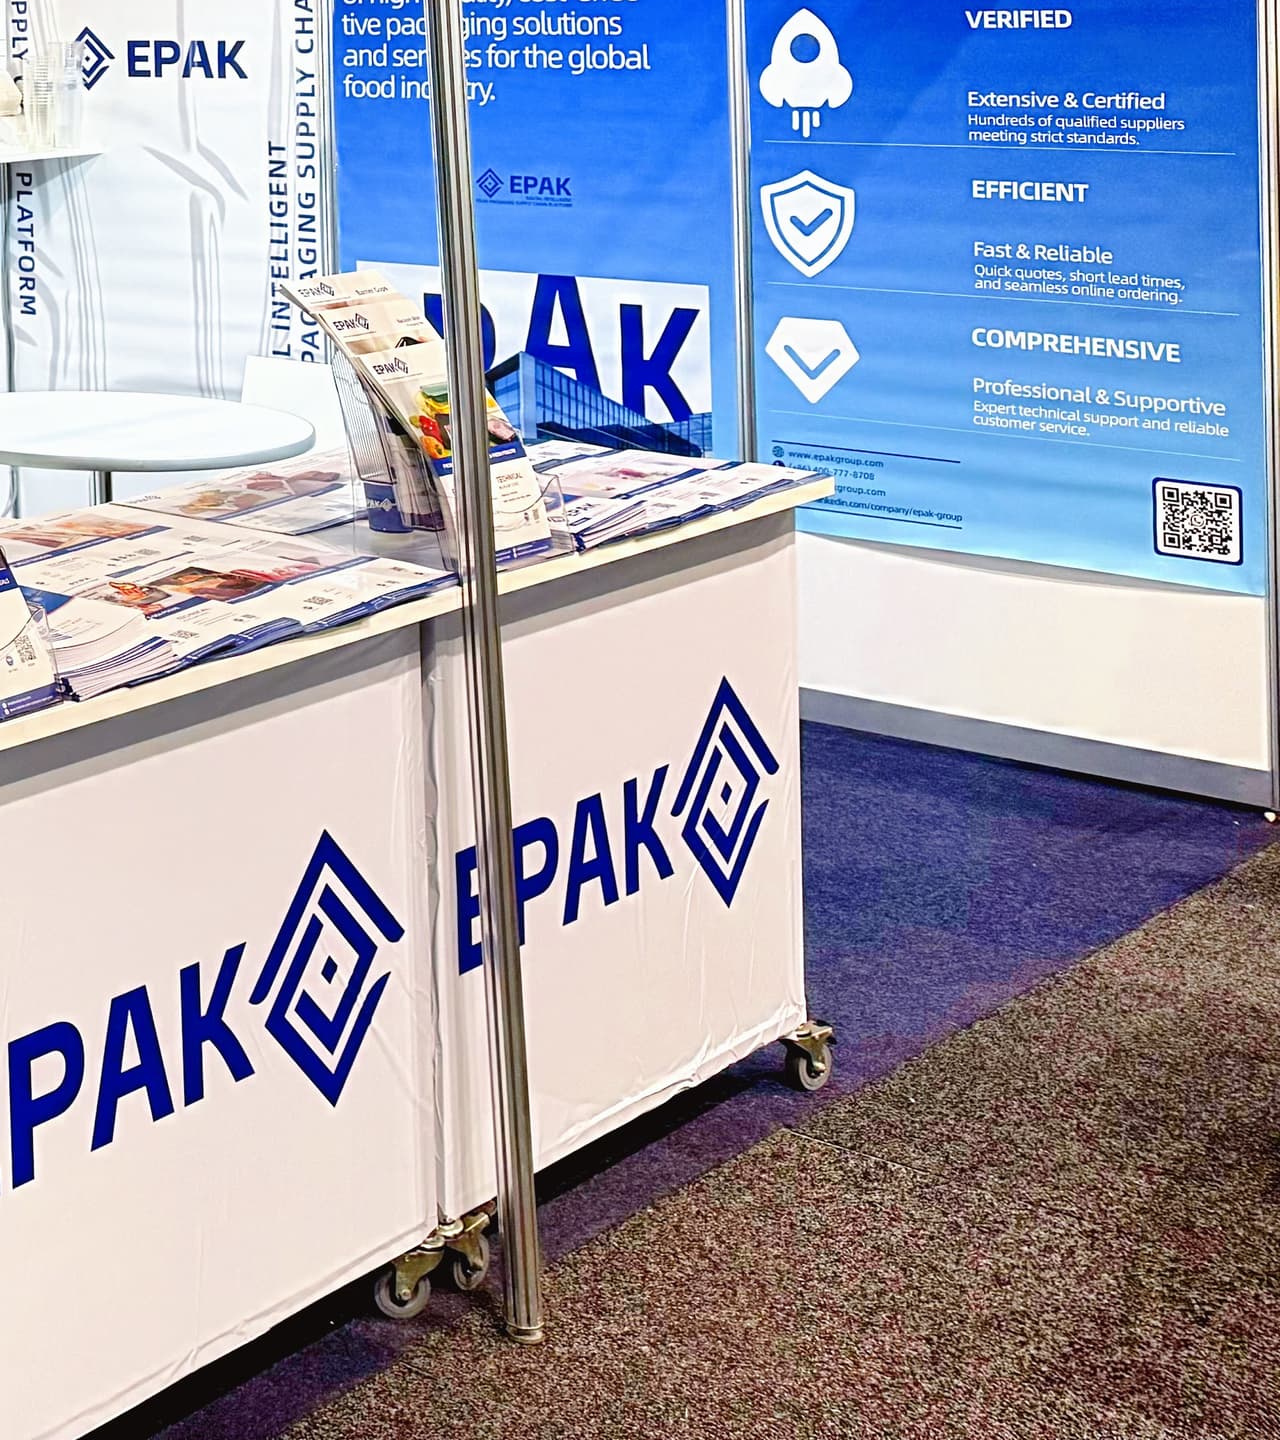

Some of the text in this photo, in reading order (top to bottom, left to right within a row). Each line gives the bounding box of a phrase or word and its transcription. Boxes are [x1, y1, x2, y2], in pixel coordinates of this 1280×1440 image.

[342, 10, 622, 35] tive solutions
[965, 10, 1072, 29] VERIFIED
[127, 40, 248, 78] EPAK
[343, 43, 651, 75] and for the global
[343, 74, 395, 99] food
[968, 91, 1165, 110] Extensive & Certified
[510, 174, 571, 196] EPAK
[972, 180, 1088, 203] EFFICIENT
[16, 172, 37, 315] PLATFORM
[973, 241, 1113, 264] Fast & Reliable
[971, 328, 1181, 363] COMPREHENSIVE
[973, 377, 1226, 416] Professional & Supportive
[973, 400, 1230, 436] Expert technical support and reliable
[973, 414, 1090, 436] customer service.
[455, 763, 674, 975] EPAK
